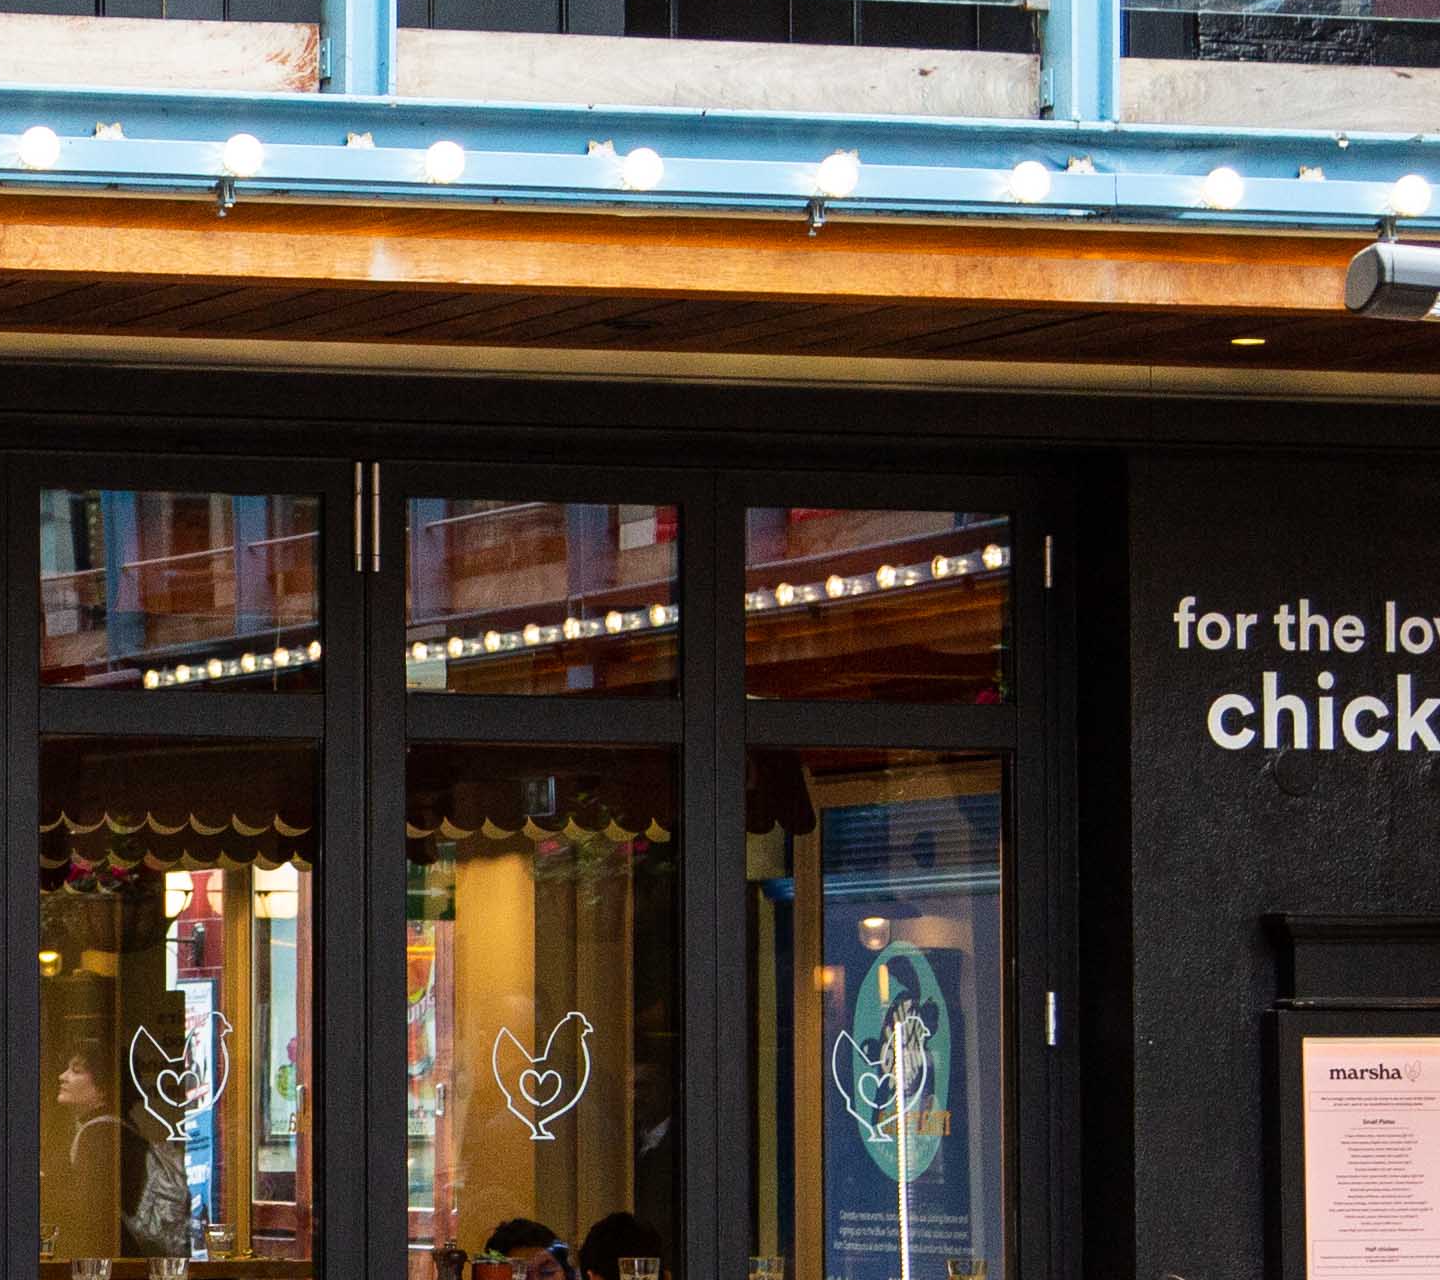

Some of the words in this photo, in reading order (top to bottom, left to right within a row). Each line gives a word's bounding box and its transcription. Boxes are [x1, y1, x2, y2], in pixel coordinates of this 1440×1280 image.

[1173, 596, 1258, 650] for
[1274, 598, 1366, 653] the
[1329, 1063, 1403, 1081] marsha
